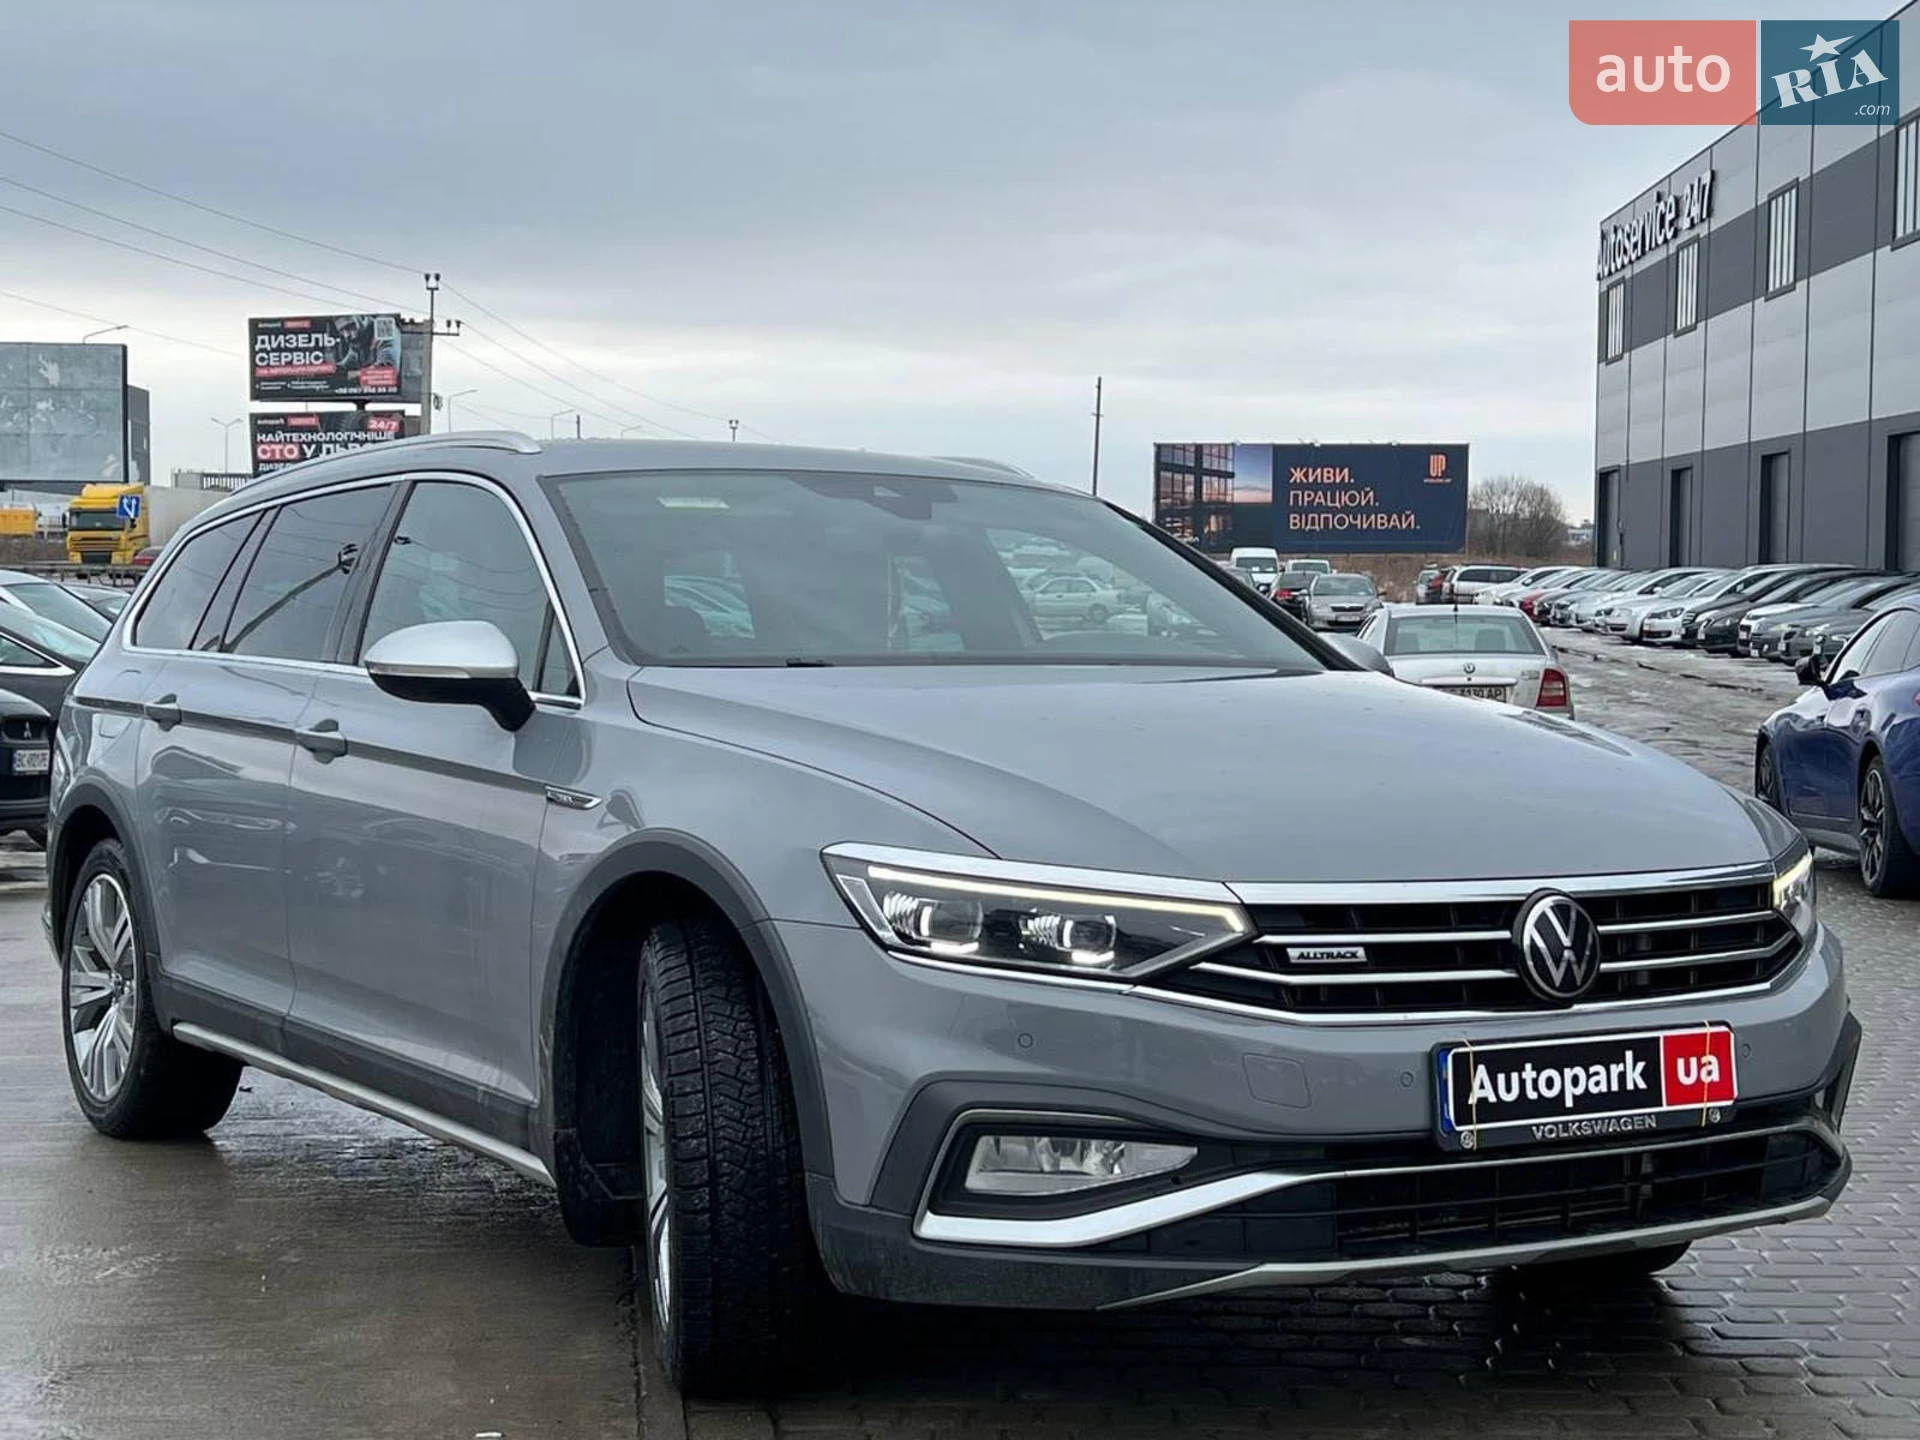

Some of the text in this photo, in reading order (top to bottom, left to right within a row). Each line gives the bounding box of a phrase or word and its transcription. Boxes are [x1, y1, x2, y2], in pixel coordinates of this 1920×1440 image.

[1597, 190, 1677, 277] Autoservice
[255, 333, 341, 350] ДИЗЕЛЬ-
[255, 351, 324, 366] СЕРВІС
[367, 418, 397, 431] 24/7
[256, 444, 300, 459] СТО
[301, 443, 316, 458] У
[1289, 466, 1356, 483] ЖИВИ.
[1289, 487, 1380, 508] ПРАЦЮЙ.
[1289, 510, 1421, 531] ВІДПОЧИВАЙ.
[1467, 1049, 1721, 1108] Autopark ua
[1532, 1114, 1657, 1140] VOLKSWAGEN
